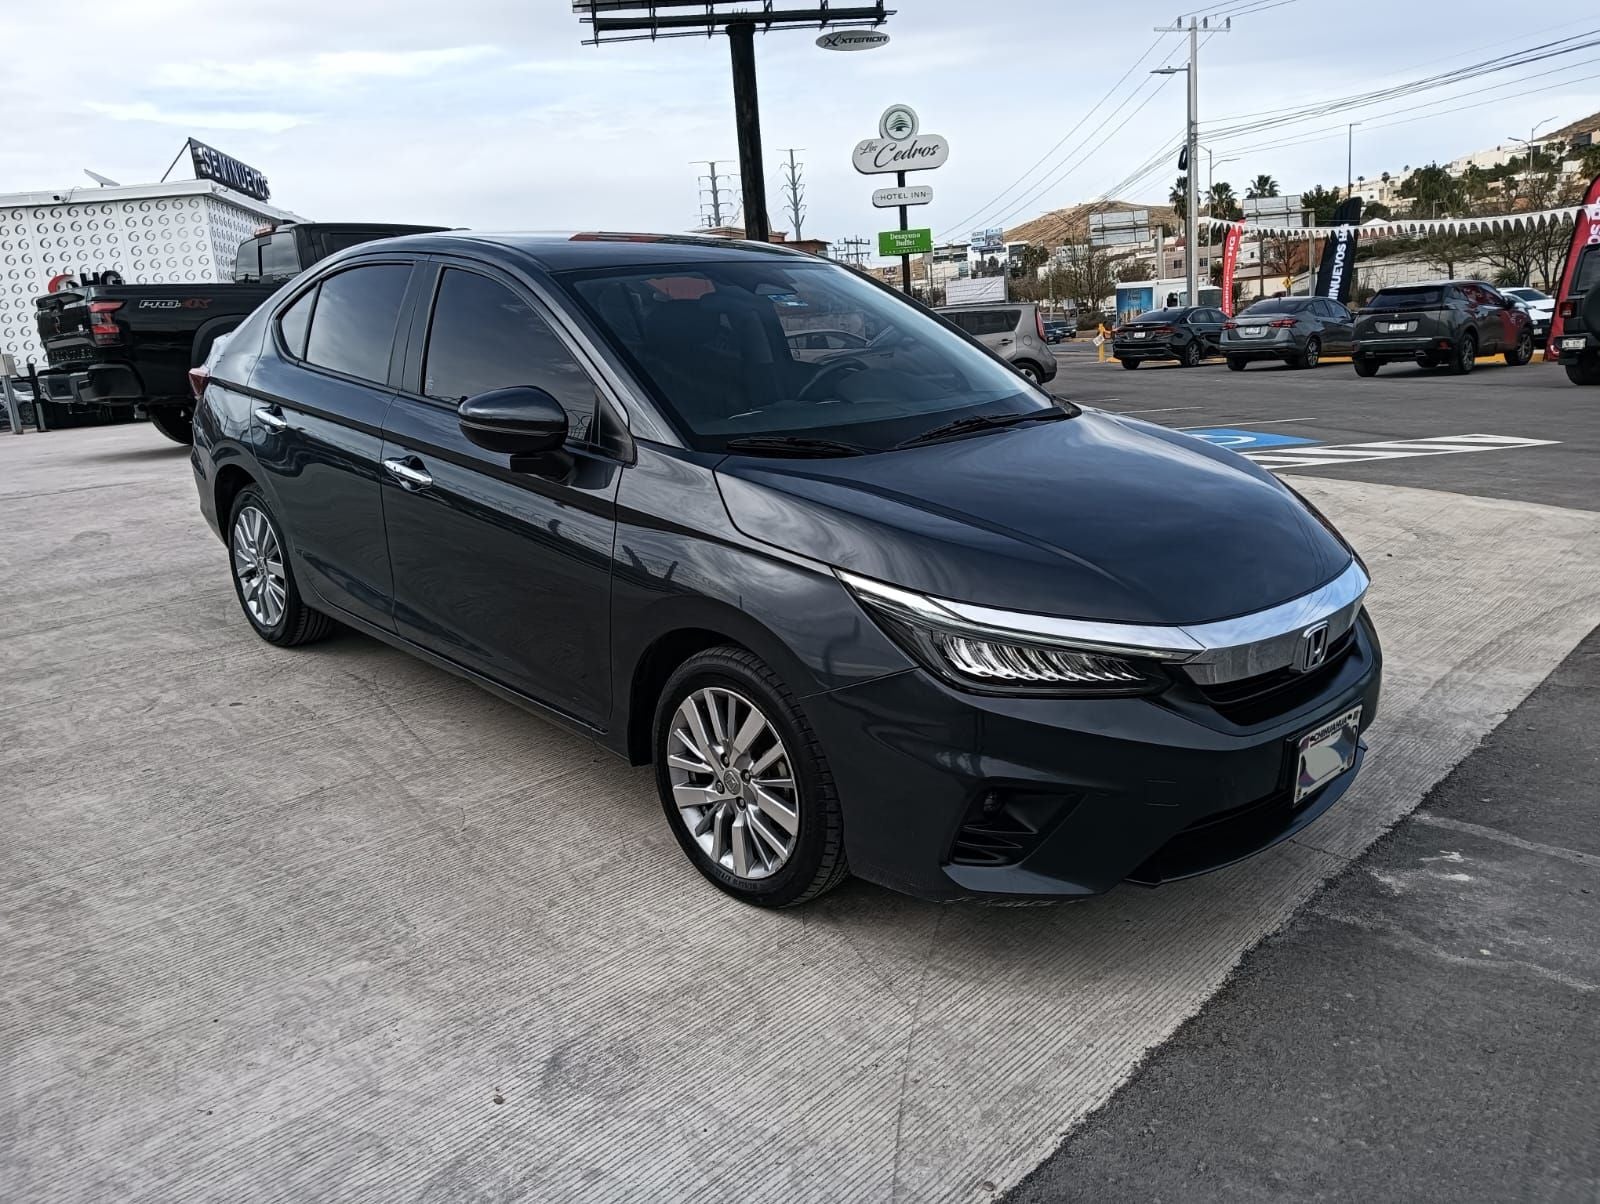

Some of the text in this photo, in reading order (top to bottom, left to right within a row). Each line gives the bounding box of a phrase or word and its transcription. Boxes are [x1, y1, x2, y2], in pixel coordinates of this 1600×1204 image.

[874, 139, 940, 168] Cedros
[202, 146, 271, 199] SEMINUEVOS
[880, 191, 927, 201] HOTEL INN
